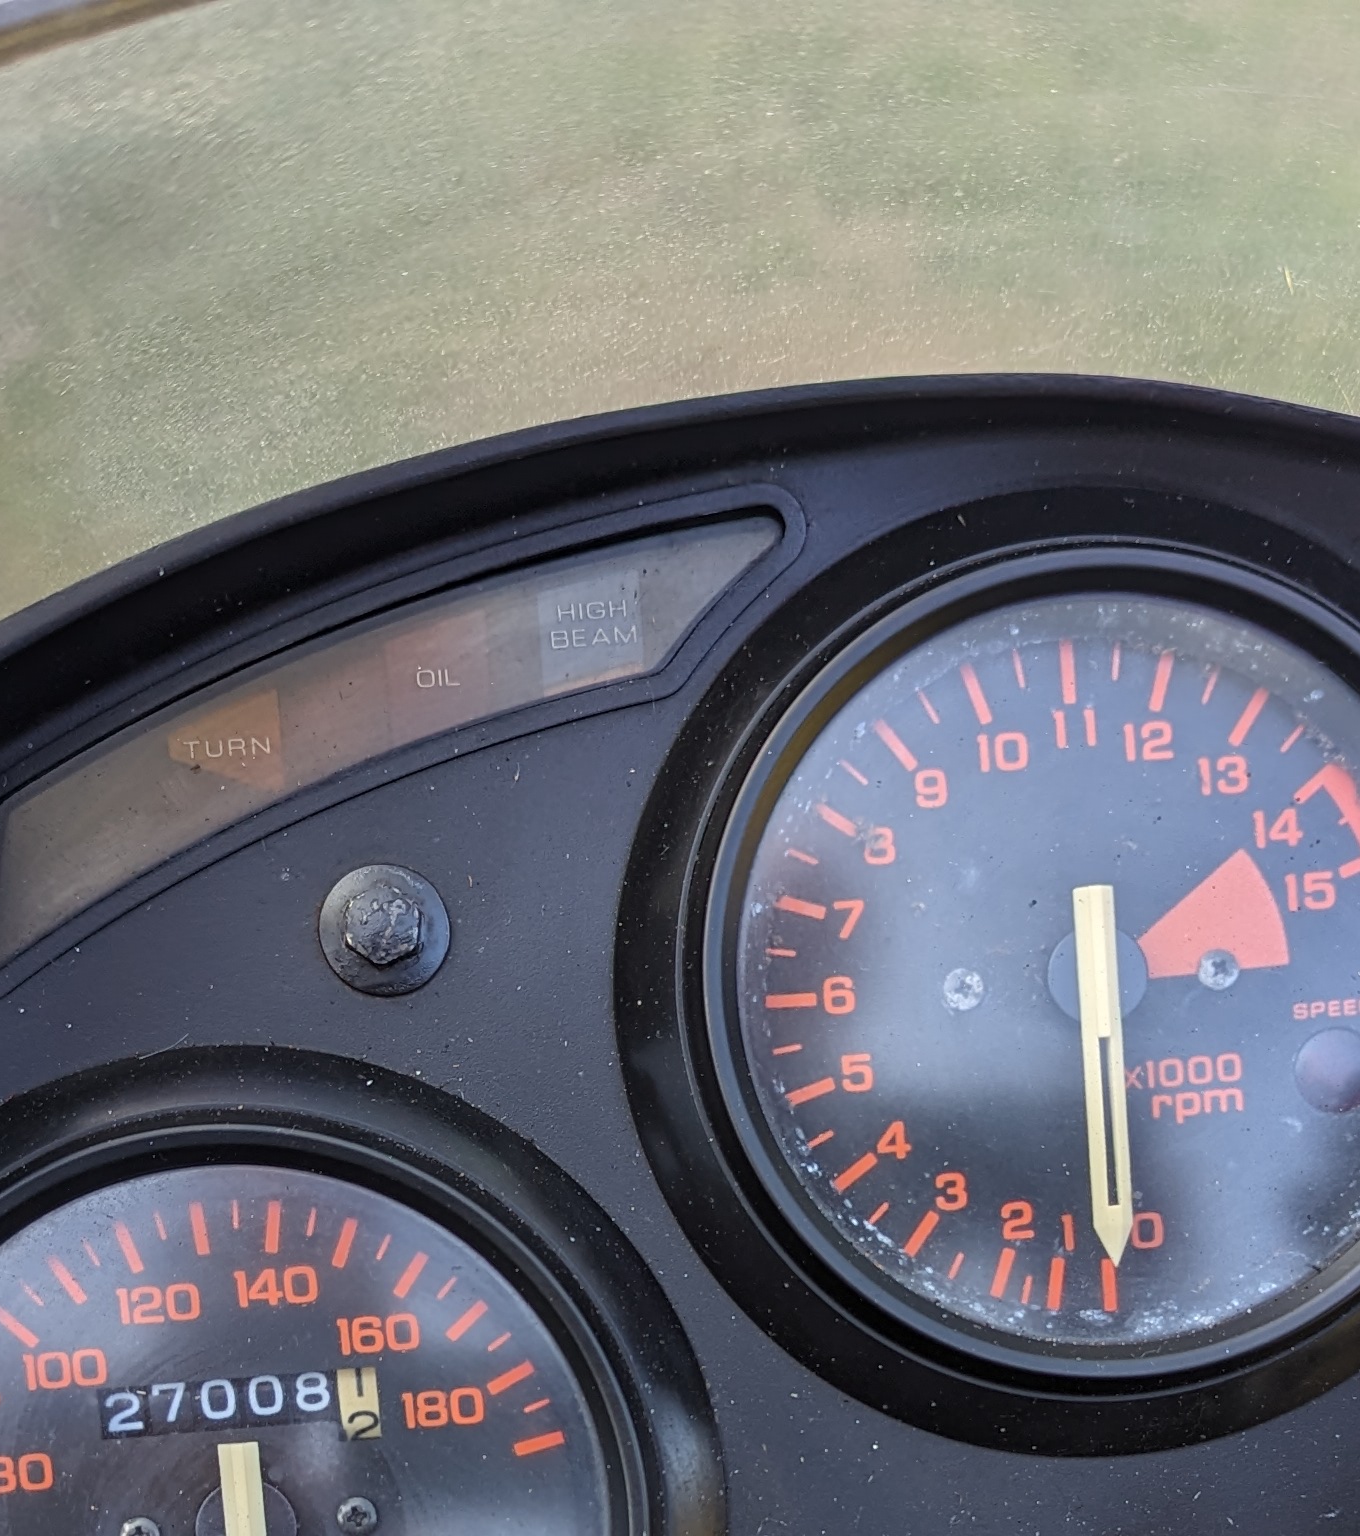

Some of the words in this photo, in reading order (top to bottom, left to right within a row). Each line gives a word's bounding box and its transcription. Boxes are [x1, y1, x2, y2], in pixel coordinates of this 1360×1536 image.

[557, 600, 627, 622] HIGH
[551, 624, 638, 649] BEAM
[415, 668, 461, 688] OIL
[1053, 709, 1096, 748] 11
[1125, 721, 1172, 760] 12
[183, 736, 272, 760] TURN
[979, 733, 1028, 771] 10
[914, 769, 947, 808] 9
[1200, 756, 1248, 794] 13
[864, 828, 896, 865] 8
[1254, 809, 1302, 847] 14
[1287, 872, 1334, 909] 15
[833, 900, 864, 939] 7
[824, 978, 854, 1013] 6
[842, 1055, 872, 1091] 5
[1151, 1087, 1244, 1124] rpm
[877, 1122, 911, 1160] 4
[935, 1174, 968, 1212] 3
[1002, 1201, 1033, 1239] 2
[1062, 1214, 1075, 1251] 1
[1131, 1213, 1163, 1248] 0
[119, 1284, 200, 1323] 120
[235, 1266, 317, 1306] 140
[338, 1316, 418, 1354] 160
[25, 1348, 107, 1389] 100
[405, 1389, 483, 1426] 180
